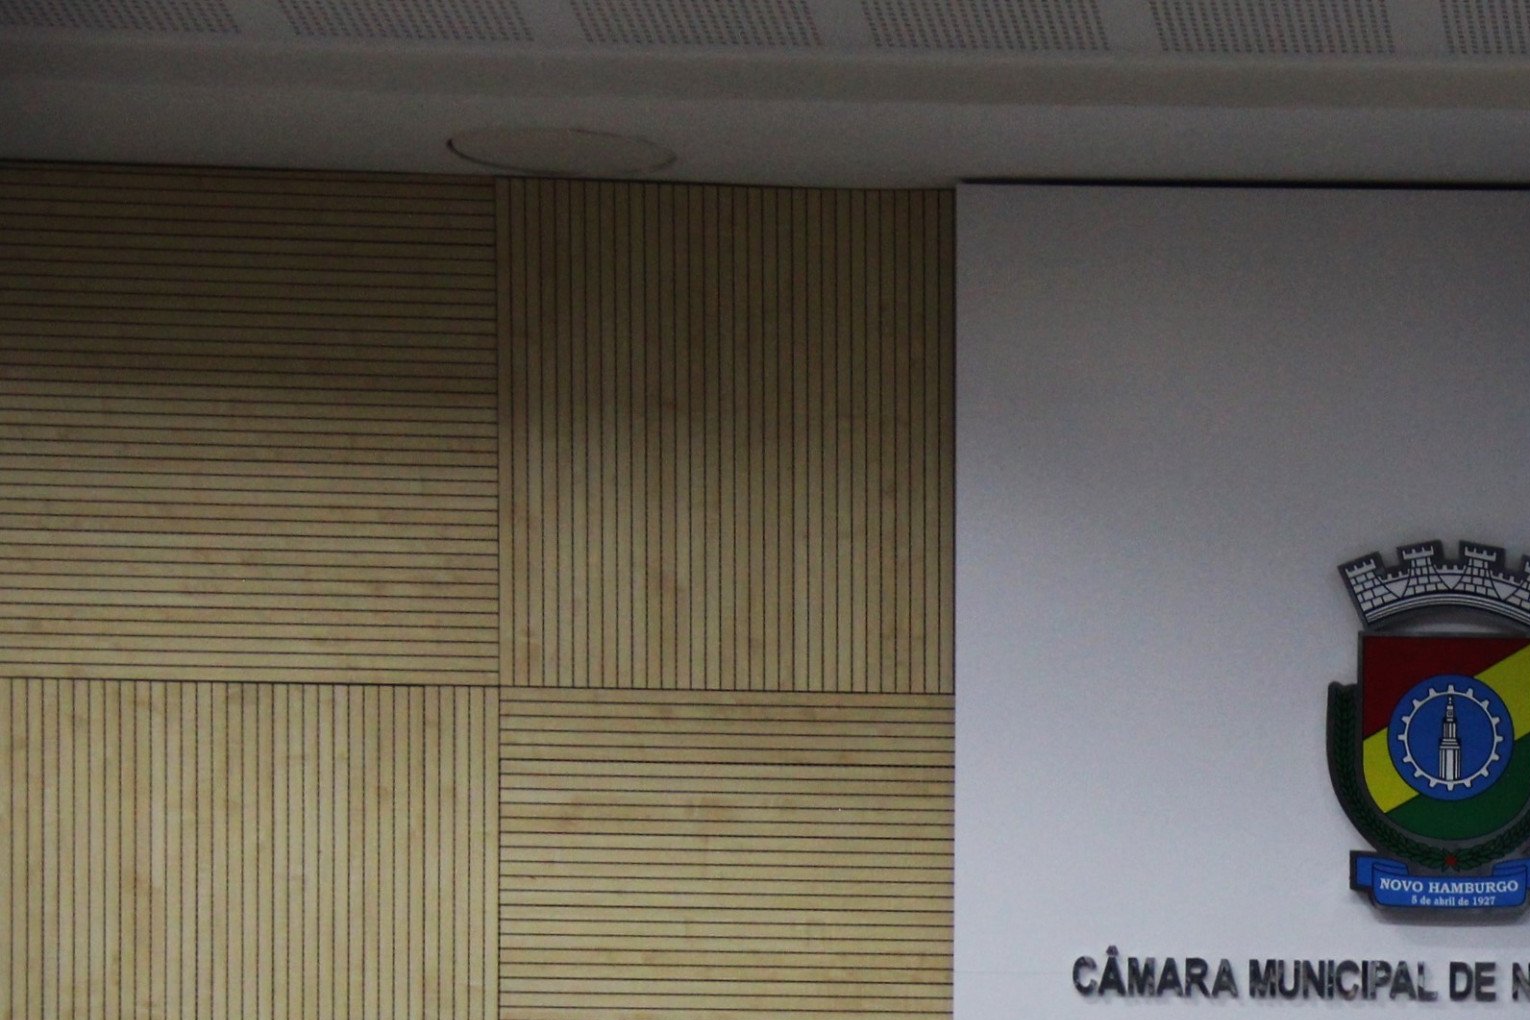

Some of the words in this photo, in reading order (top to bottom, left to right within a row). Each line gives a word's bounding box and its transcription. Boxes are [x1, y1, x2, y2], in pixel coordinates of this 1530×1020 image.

[1379, 877, 1424, 893] NOVO
[1428, 880, 1519, 894] HAMBURGO
[1419, 895, 1431, 905] de
[1434, 895, 1456, 906] abril
[1458, 896, 1469, 906] de
[1473, 896, 1496, 907] 1927
[1072, 945, 1239, 999] CÂMARA
[1248, 958, 1438, 1001] MUNICIPAL
[1448, 960, 1497, 1003] DE
